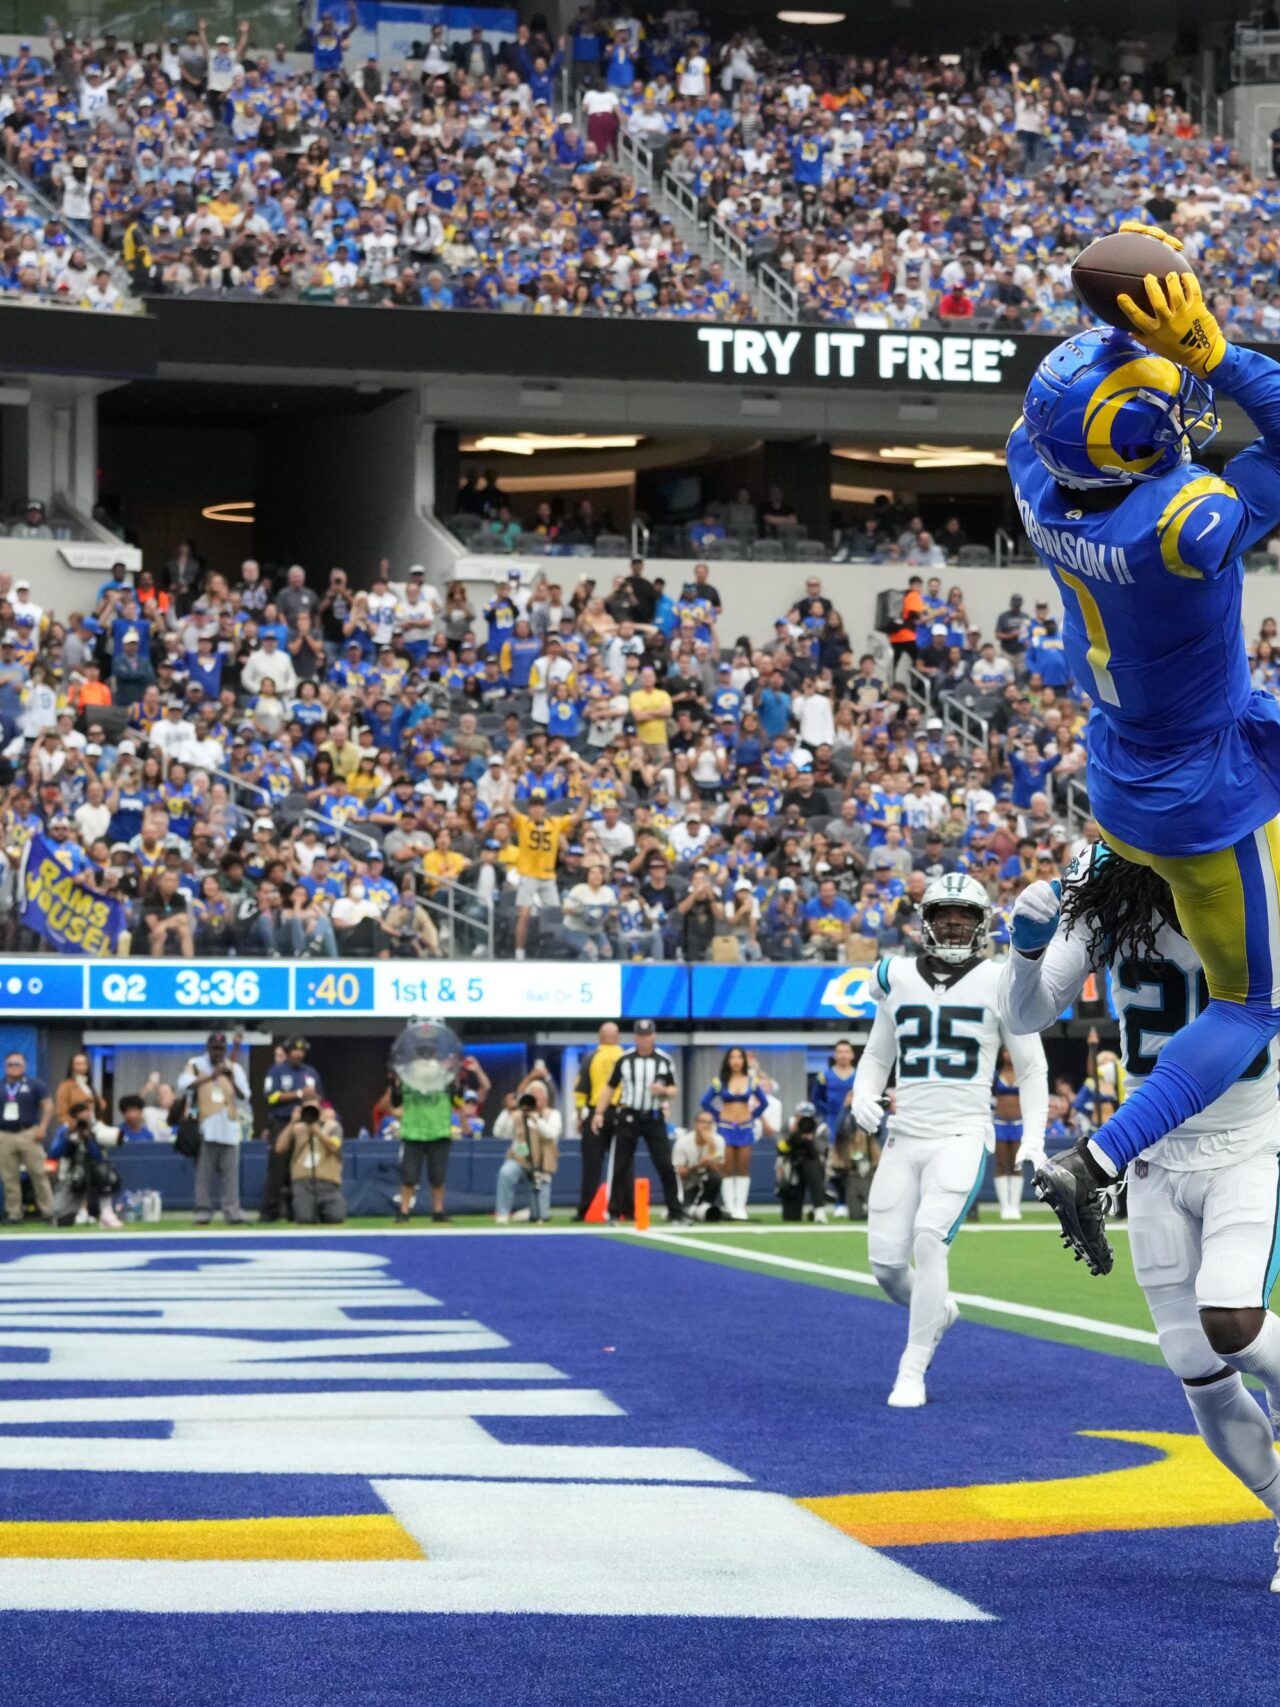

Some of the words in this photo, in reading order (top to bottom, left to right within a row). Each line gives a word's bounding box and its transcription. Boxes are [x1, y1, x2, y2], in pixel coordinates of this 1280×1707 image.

[1192, 318, 1211, 349] adidas
[698, 328, 801, 375] TRY
[814, 332, 866, 377] IT
[1053, 564, 1121, 708] 1
[528, 829, 553, 851] 95
[39, 858, 111, 929] RAMS
[102, 974, 147, 1003] Q2
[175, 970, 260, 1006] 3:36
[389, 977, 430, 1004] 1st
[436, 976, 458, 1004] &
[466, 976, 486, 1004] 5
[579, 982, 594, 1004] 5
[894, 1004, 985, 1080] 25
